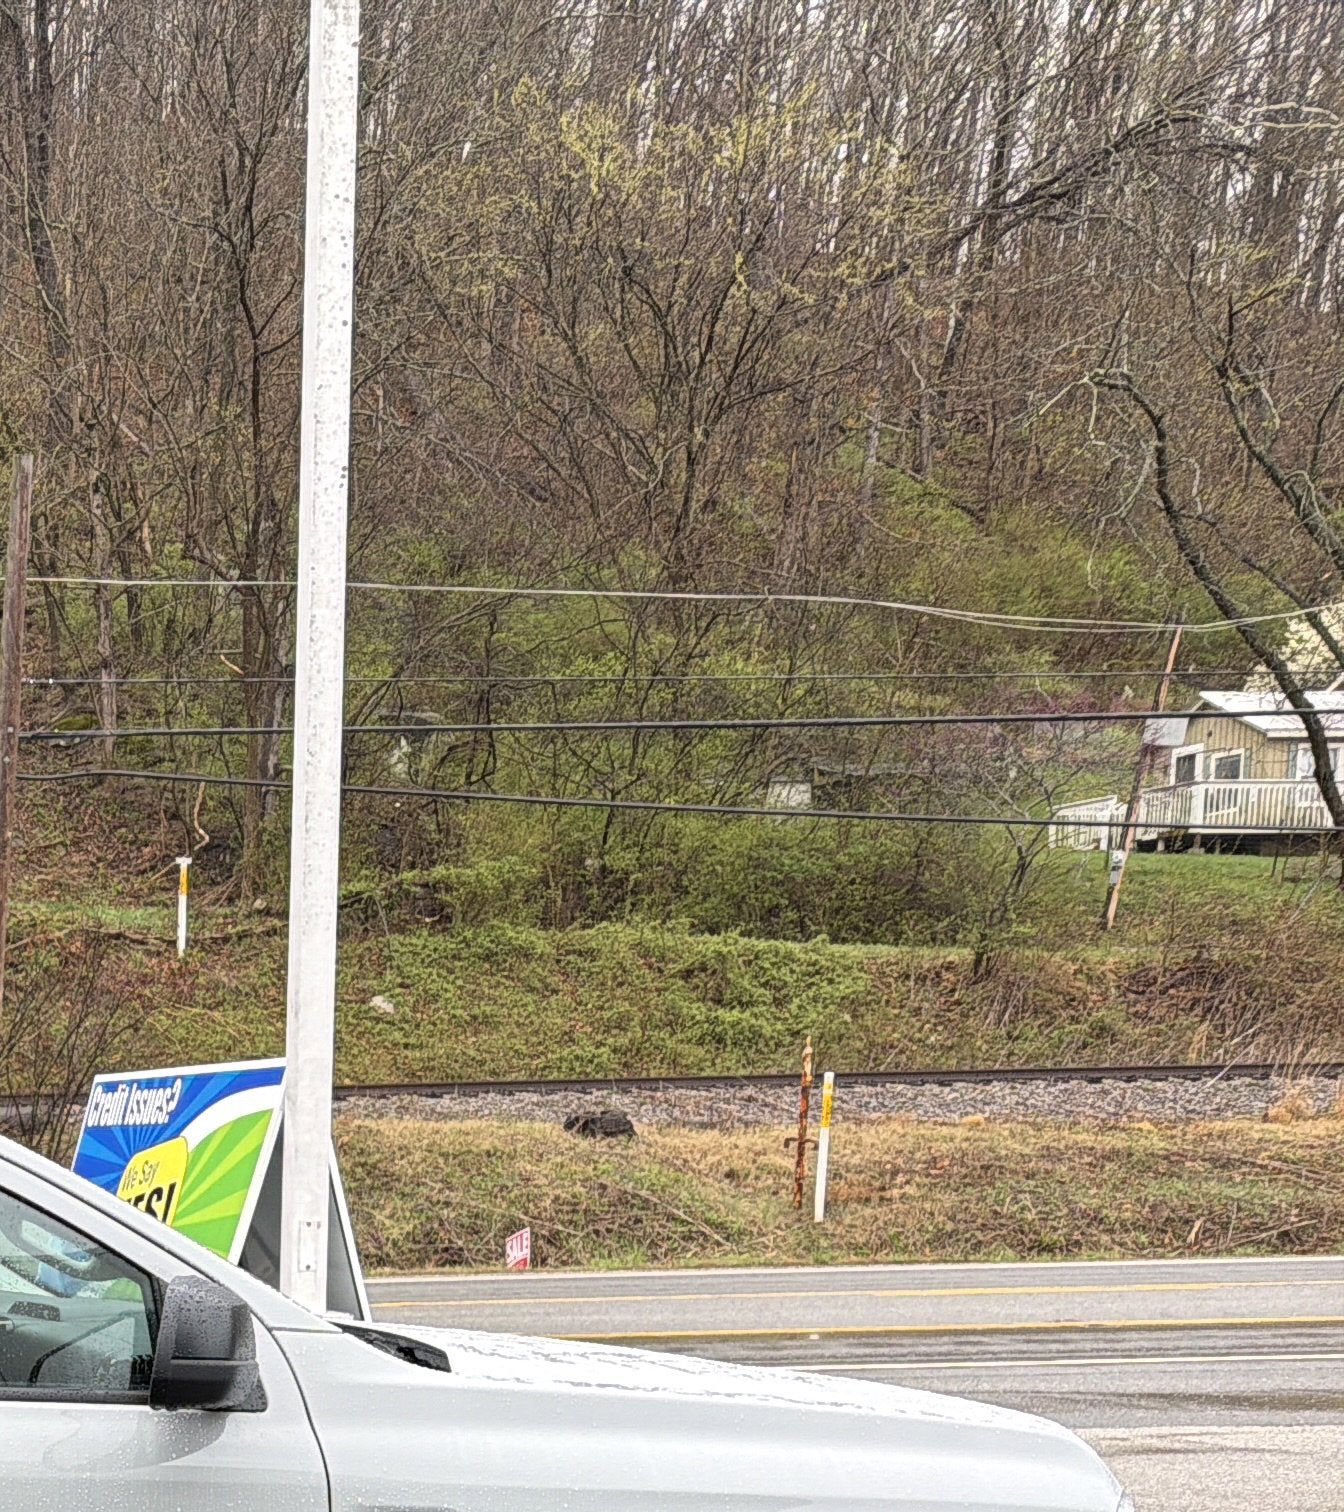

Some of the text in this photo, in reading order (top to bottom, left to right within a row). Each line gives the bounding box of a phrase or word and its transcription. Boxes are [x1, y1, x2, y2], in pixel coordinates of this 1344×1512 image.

[87, 1077, 182, 1128] Credit Issues?
[139, 1159, 161, 1188] Say
